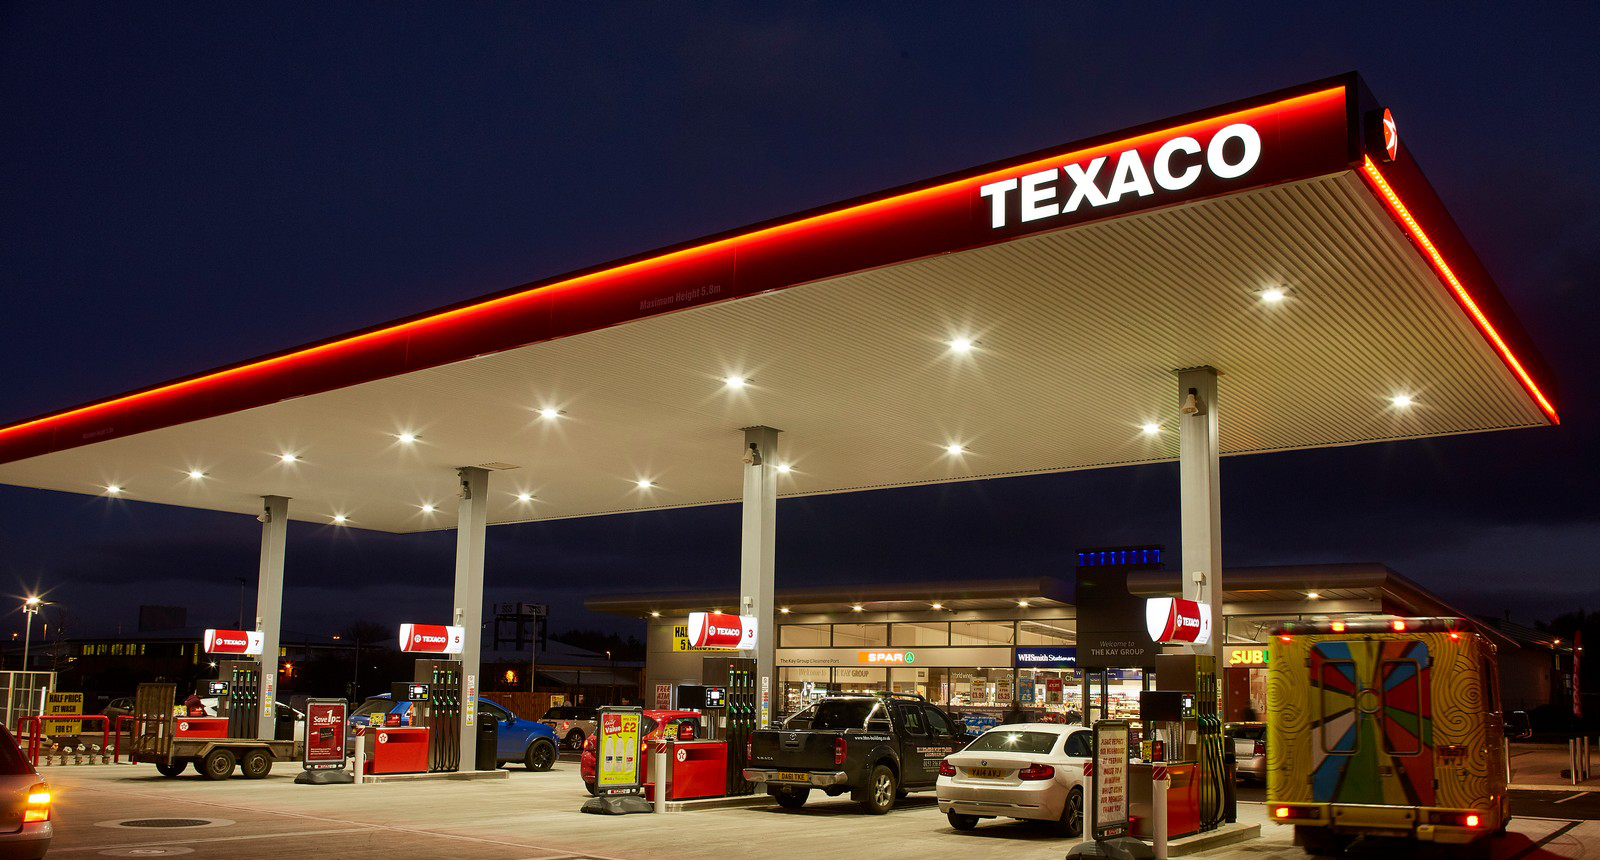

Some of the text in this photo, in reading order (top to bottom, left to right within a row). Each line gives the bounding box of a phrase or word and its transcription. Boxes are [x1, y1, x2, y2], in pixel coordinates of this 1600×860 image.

[980, 123, 1261, 229] TEXACO
[640, 284, 721, 311] Maximum Height 5.8m
[1182, 616, 1200, 628] TEXACO
[1205, 619, 1208, 630] 1
[675, 626, 688, 636] HAL
[716, 627, 740, 637] TEXACO
[748, 629, 754, 638] 3
[680, 638, 686, 650] 5
[1091, 648, 1145, 656] THE KAY GROUP
[868, 653, 903, 662] SPAR
[1018, 653, 1049, 662] WHSmith
[851, 669, 869, 678] GROUP
[49, 694, 82, 703] HALF PRICE
[52, 705, 77, 713] JET WASH
[623, 722, 636, 733] £2
